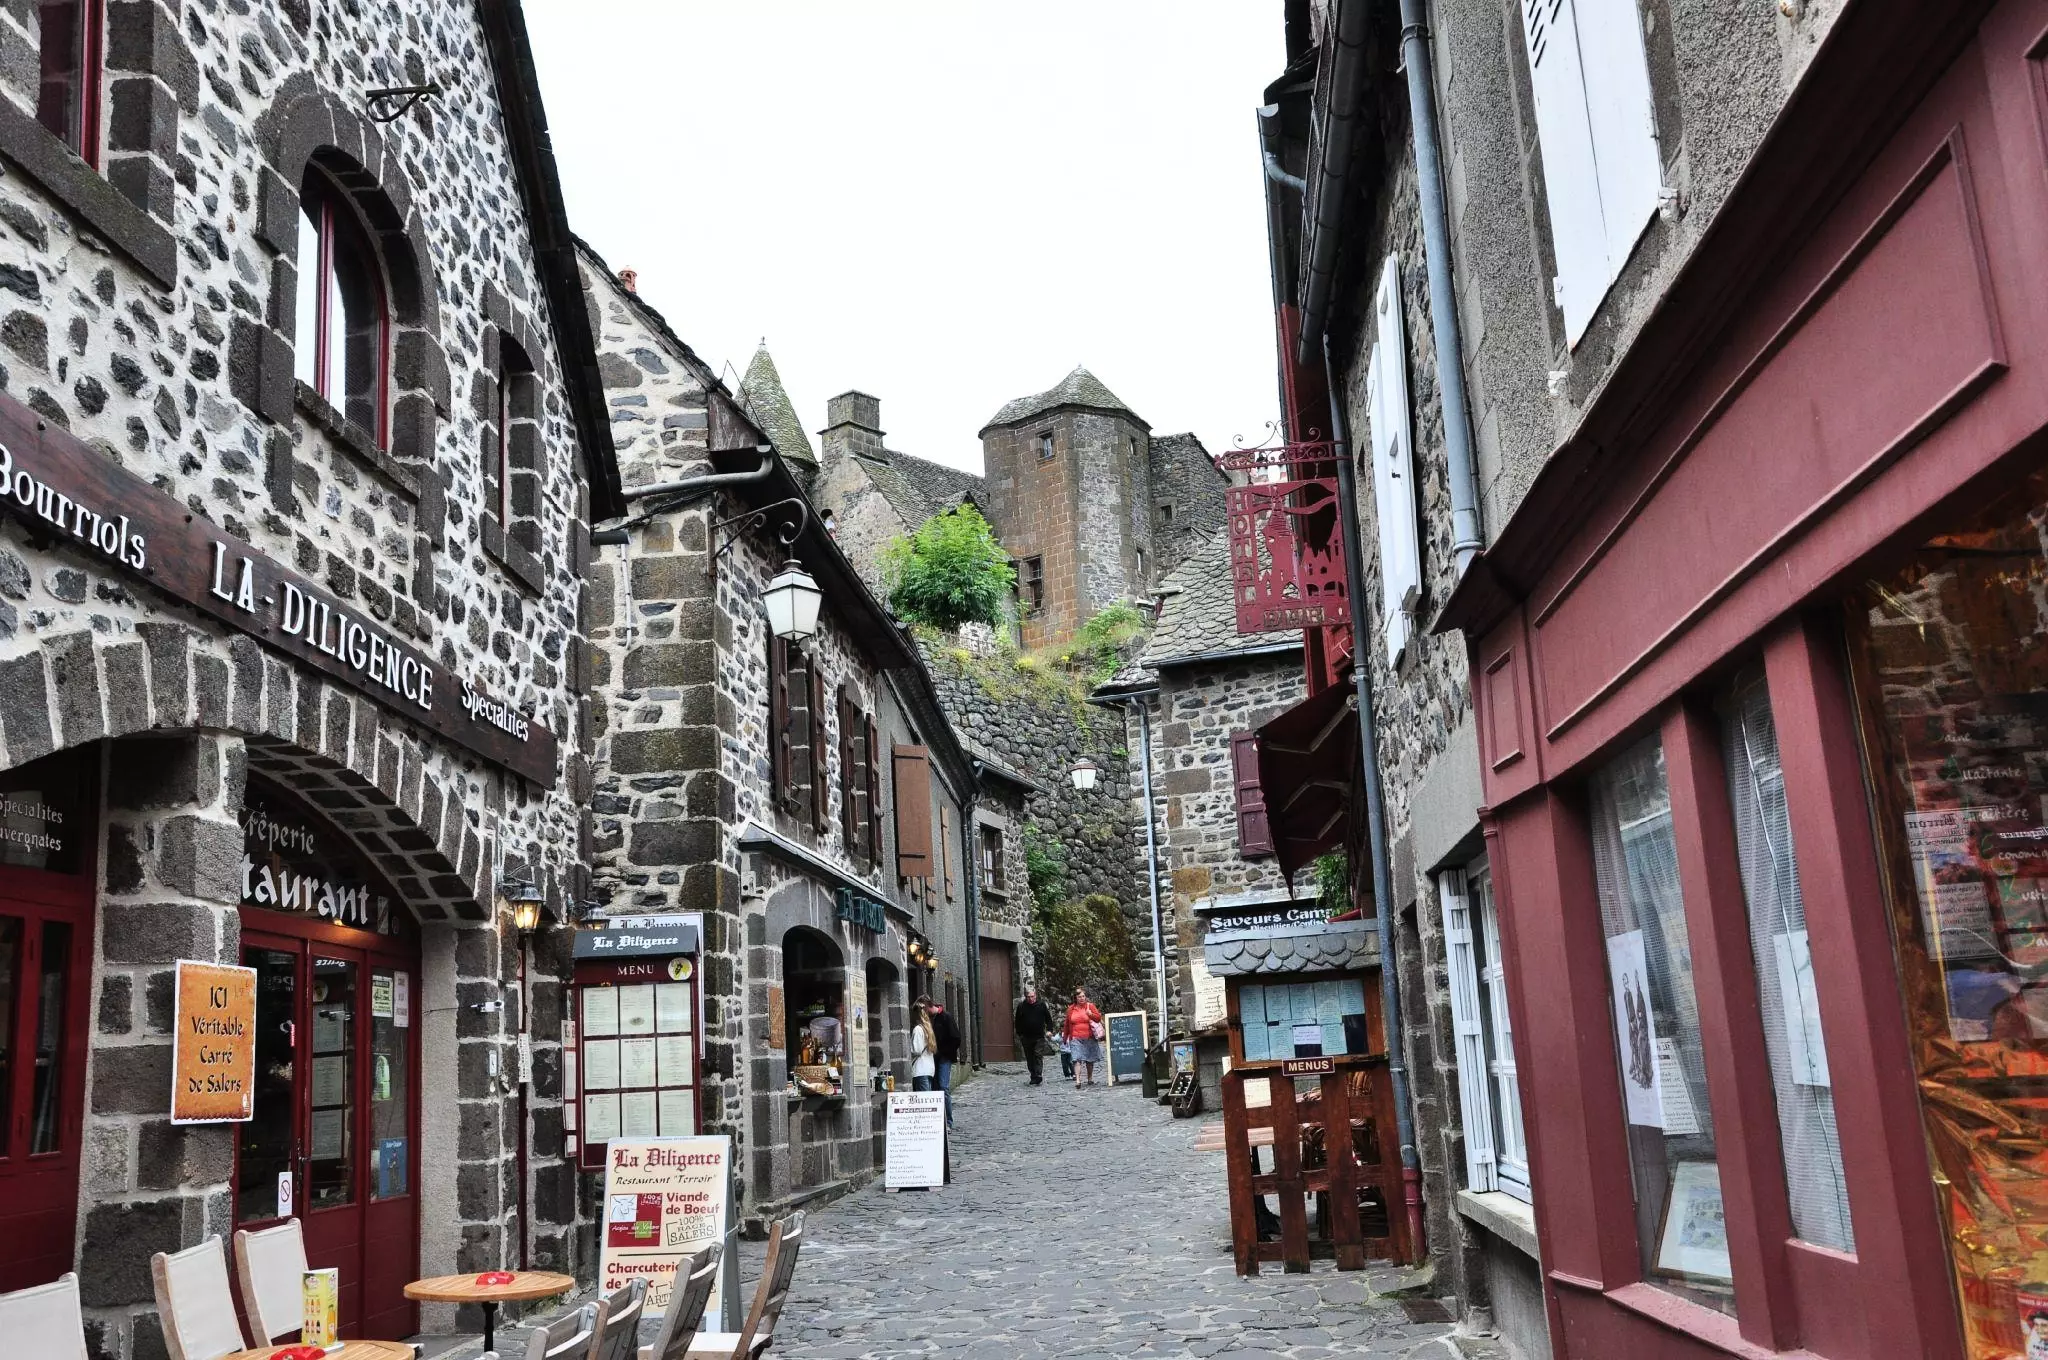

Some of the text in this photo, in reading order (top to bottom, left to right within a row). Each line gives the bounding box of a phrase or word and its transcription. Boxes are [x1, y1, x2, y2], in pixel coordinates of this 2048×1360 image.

[212, 540, 256, 613] LA
[281, 581, 433, 710] DILIGENCE
[241, 852, 370, 925] taurant
[1211, 912, 1282, 929] Saveurs
[592, 935, 678, 951] La Diligence
[617, 964, 655, 976] MENU
[210, 986, 228, 1009] ICI
[191, 1015, 244, 1036] Véritable
[200, 1044, 233, 1064] Carré
[1288, 1060, 1330, 1072] MENUS
[189, 1072, 242, 1093] de Salers
[889, 1094, 942, 1107] Le Buron
[614, 1147, 721, 1173] La Diligence
[616, 1174, 671, 1185] Restaurant
[667, 1192, 710, 1202] Viande
[666, 1203, 720, 1214] de Boeuf
[670, 1225, 715, 1243] SALERS
[606, 1278, 622, 1290] de
